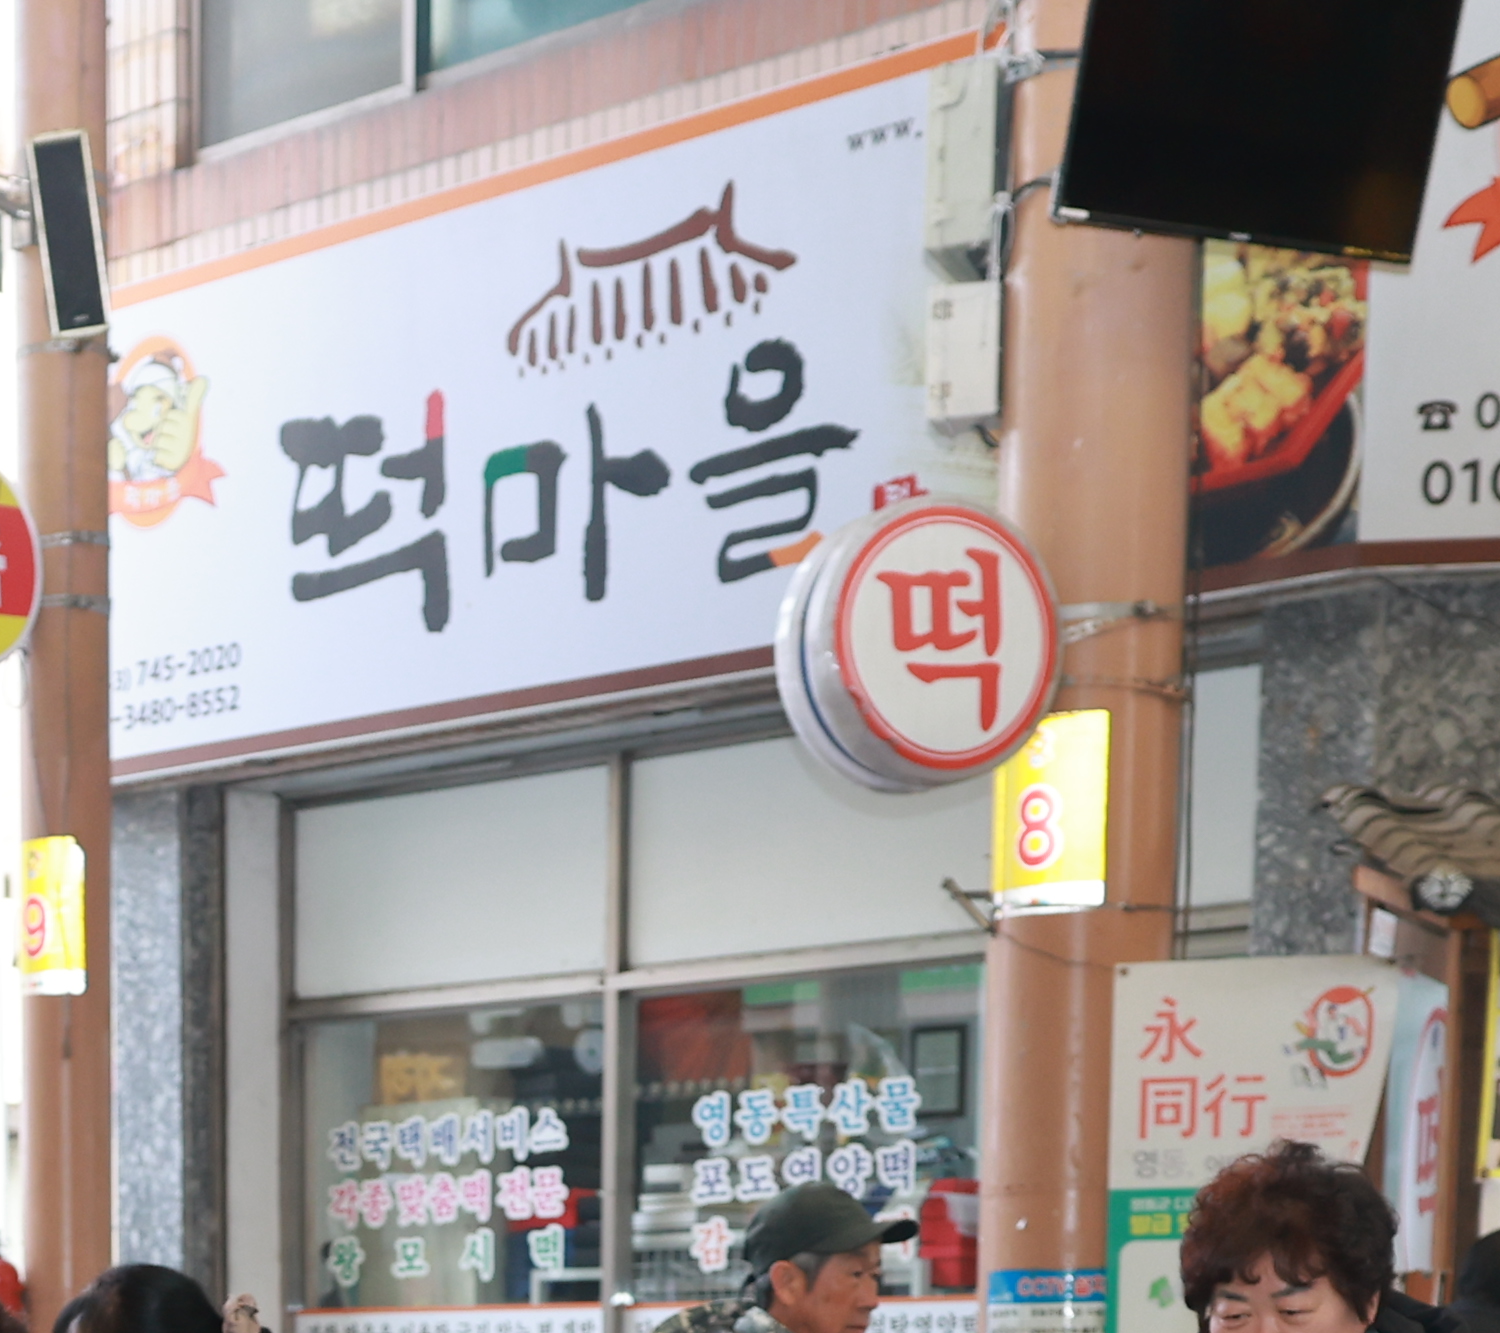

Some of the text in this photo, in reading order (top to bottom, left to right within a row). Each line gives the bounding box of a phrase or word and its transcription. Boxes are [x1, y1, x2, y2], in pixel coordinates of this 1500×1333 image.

[279, 338, 860, 633] 떡마을
[137, 642, 243, 682] 745-2020
[876, 547, 1002, 731] 떡
[110, 685, 240, 731] -3480-8552
[1018, 789, 1058, 869] 8
[1139, 996, 1204, 1063] 永
[1138, 1073, 1268, 1139] 同行
